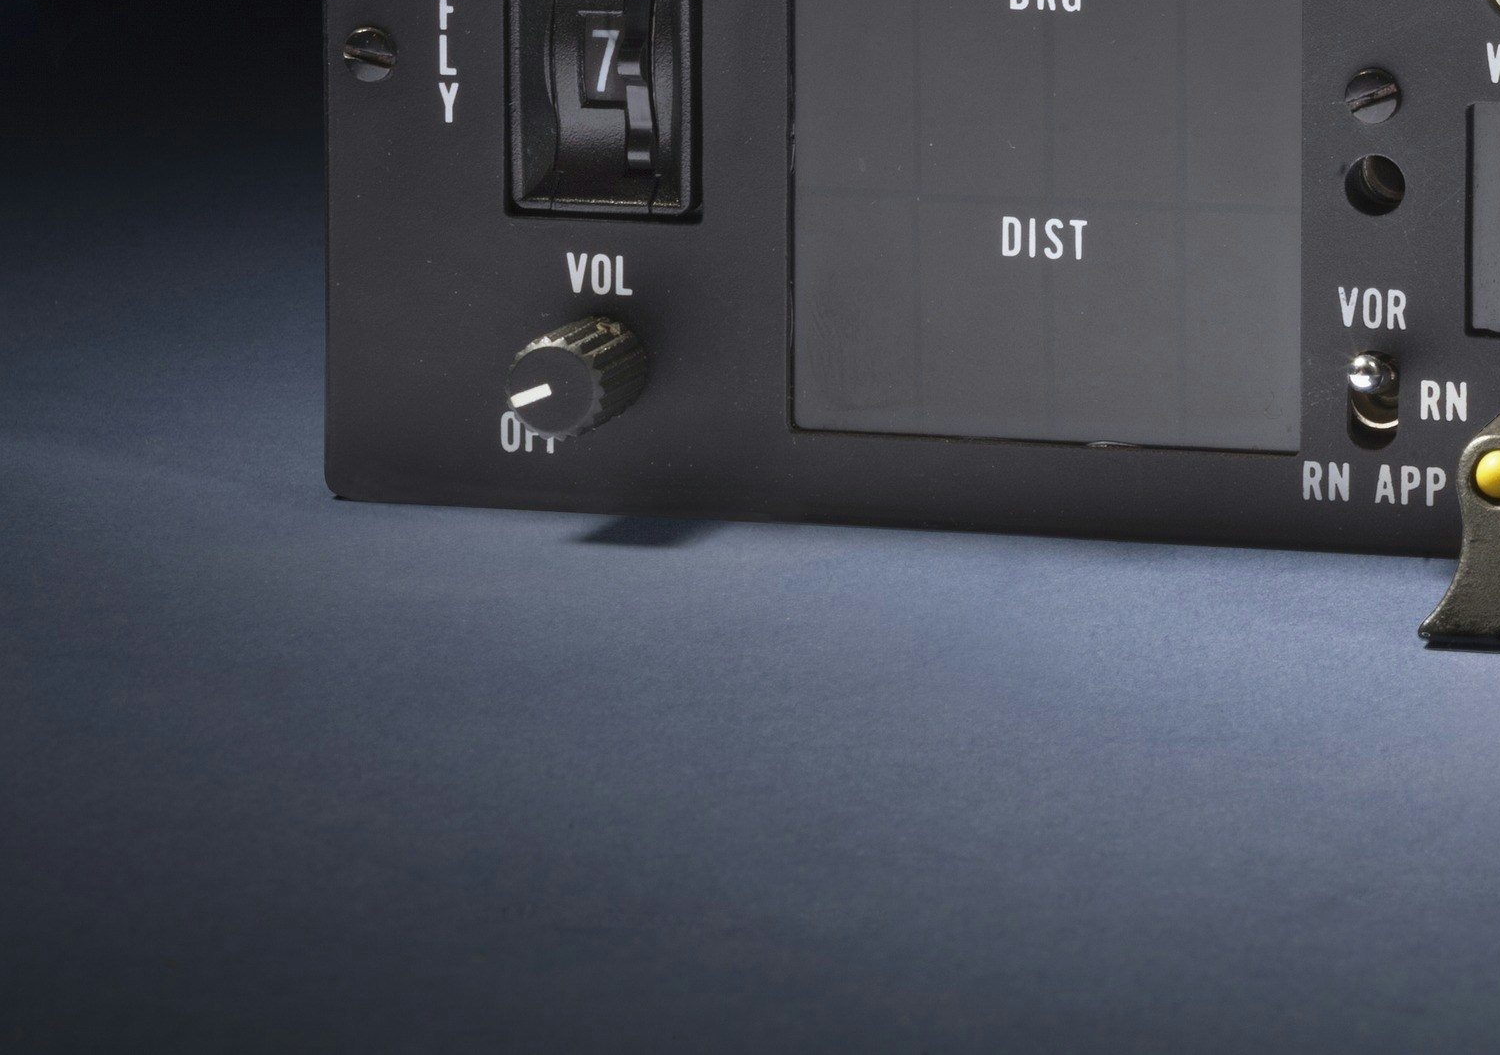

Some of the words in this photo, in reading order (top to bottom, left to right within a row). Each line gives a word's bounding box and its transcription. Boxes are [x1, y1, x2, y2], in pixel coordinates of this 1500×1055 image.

[592, 29, 619, 93] 7
[1001, 215, 1088, 261] DIST
[566, 251, 633, 296] VOL
[1337, 286, 1407, 330] VOR
[1420, 379, 1468, 422] RN
[1302, 460, 1350, 502] RN
[1374, 463, 1447, 507] APP
